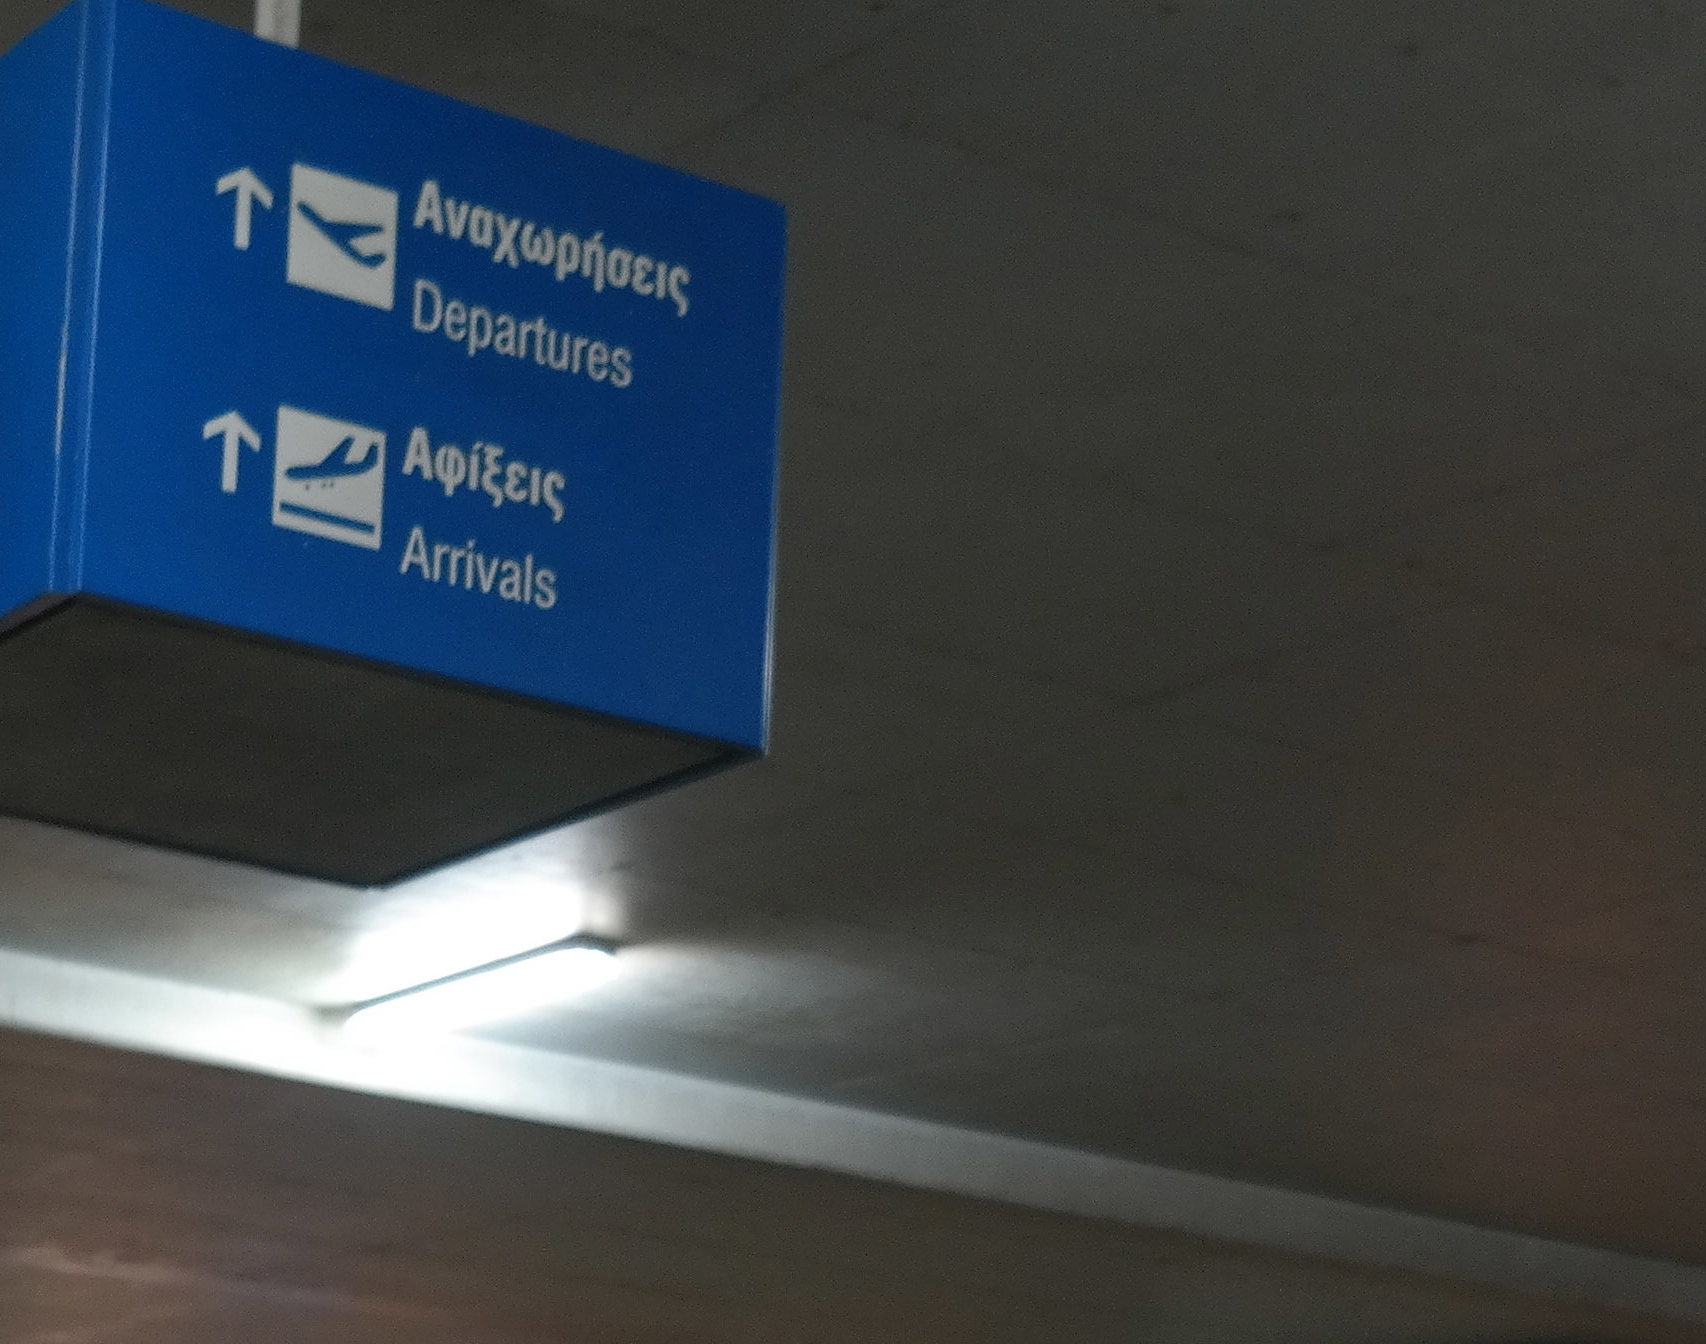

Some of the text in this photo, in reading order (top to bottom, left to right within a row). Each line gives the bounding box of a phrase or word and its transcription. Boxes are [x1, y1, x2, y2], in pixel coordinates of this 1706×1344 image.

[412, 180, 691, 317] Αναχωρήσεις
[412, 279, 634, 387] Departures
[402, 427, 567, 523] Αφίξεις
[399, 525, 558, 610] Arrivals
